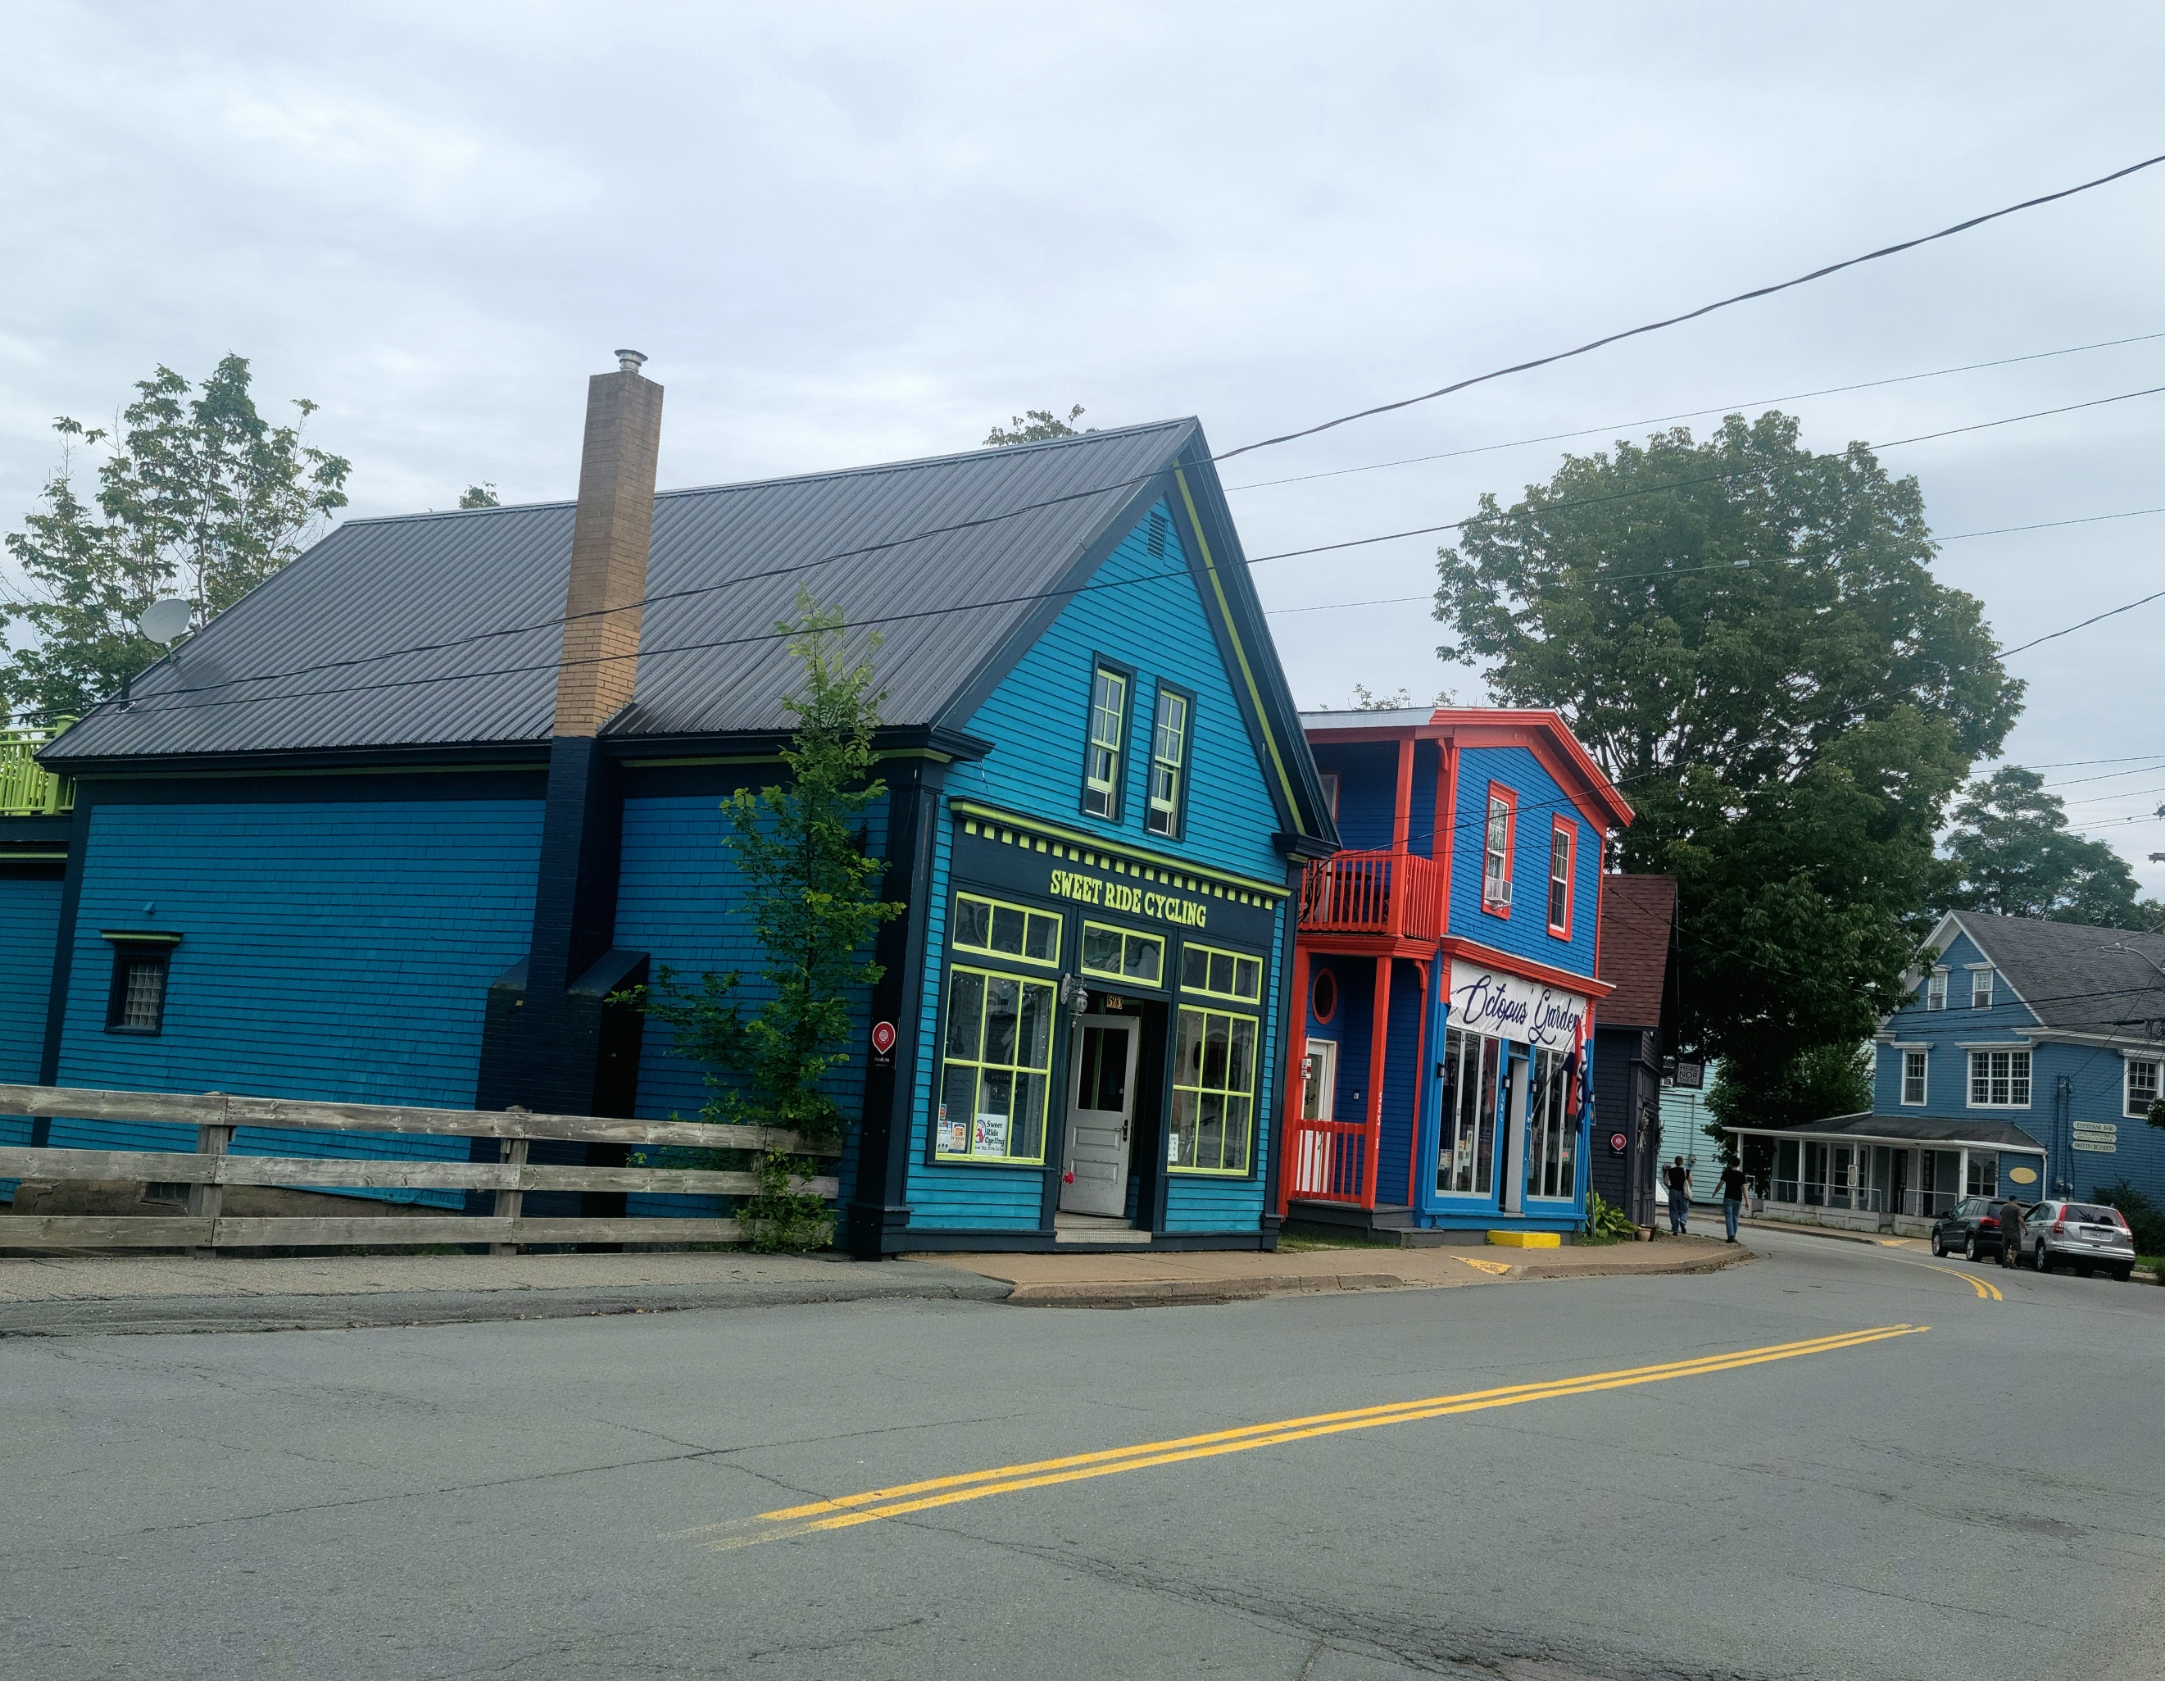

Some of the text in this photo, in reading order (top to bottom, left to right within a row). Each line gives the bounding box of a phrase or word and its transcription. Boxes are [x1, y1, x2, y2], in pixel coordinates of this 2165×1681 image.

[1050, 869, 1207, 928] SWEET RIDE CYCLING
[1108, 996, 1121, 1008] 523
[1680, 1064, 1699, 1072] HERE
[1679, 1071, 1698, 1079] NOR
[986, 1120, 1003, 1129] Sweet
[986, 1128, 999, 1137] Ride
[984, 1137, 1005, 1147] Cycling
